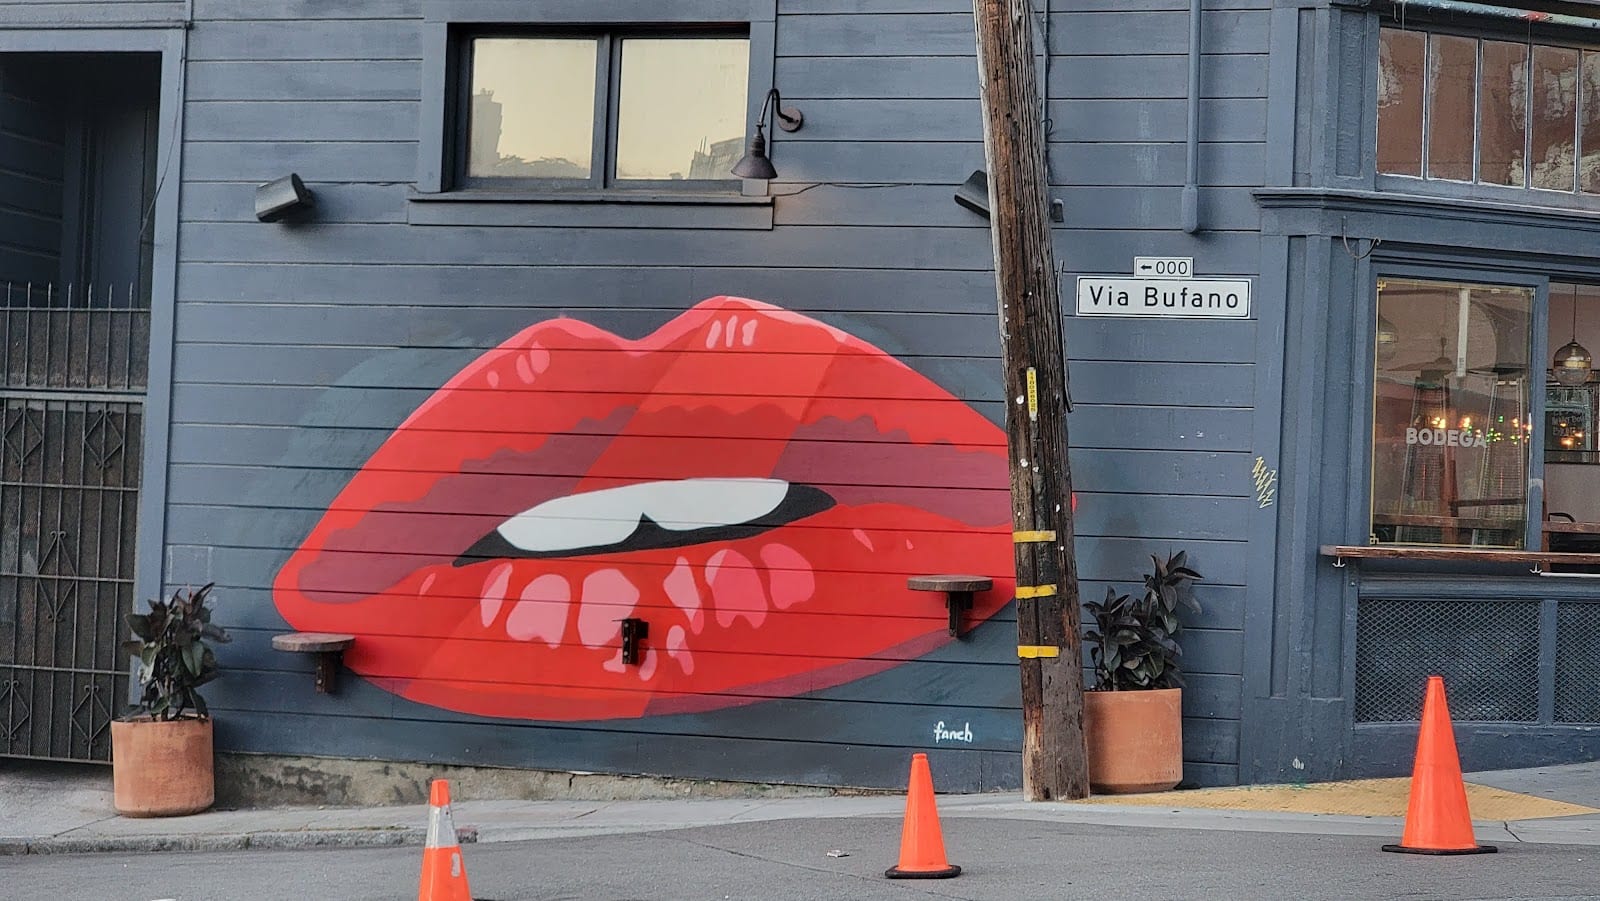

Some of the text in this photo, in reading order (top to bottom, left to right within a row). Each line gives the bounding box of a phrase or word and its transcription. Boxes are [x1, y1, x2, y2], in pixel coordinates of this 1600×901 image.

[1156, 261, 1188, 275] 000
[1089, 285, 1239, 309] Via Bufano
[1406, 427, 1487, 448] BODEGA
